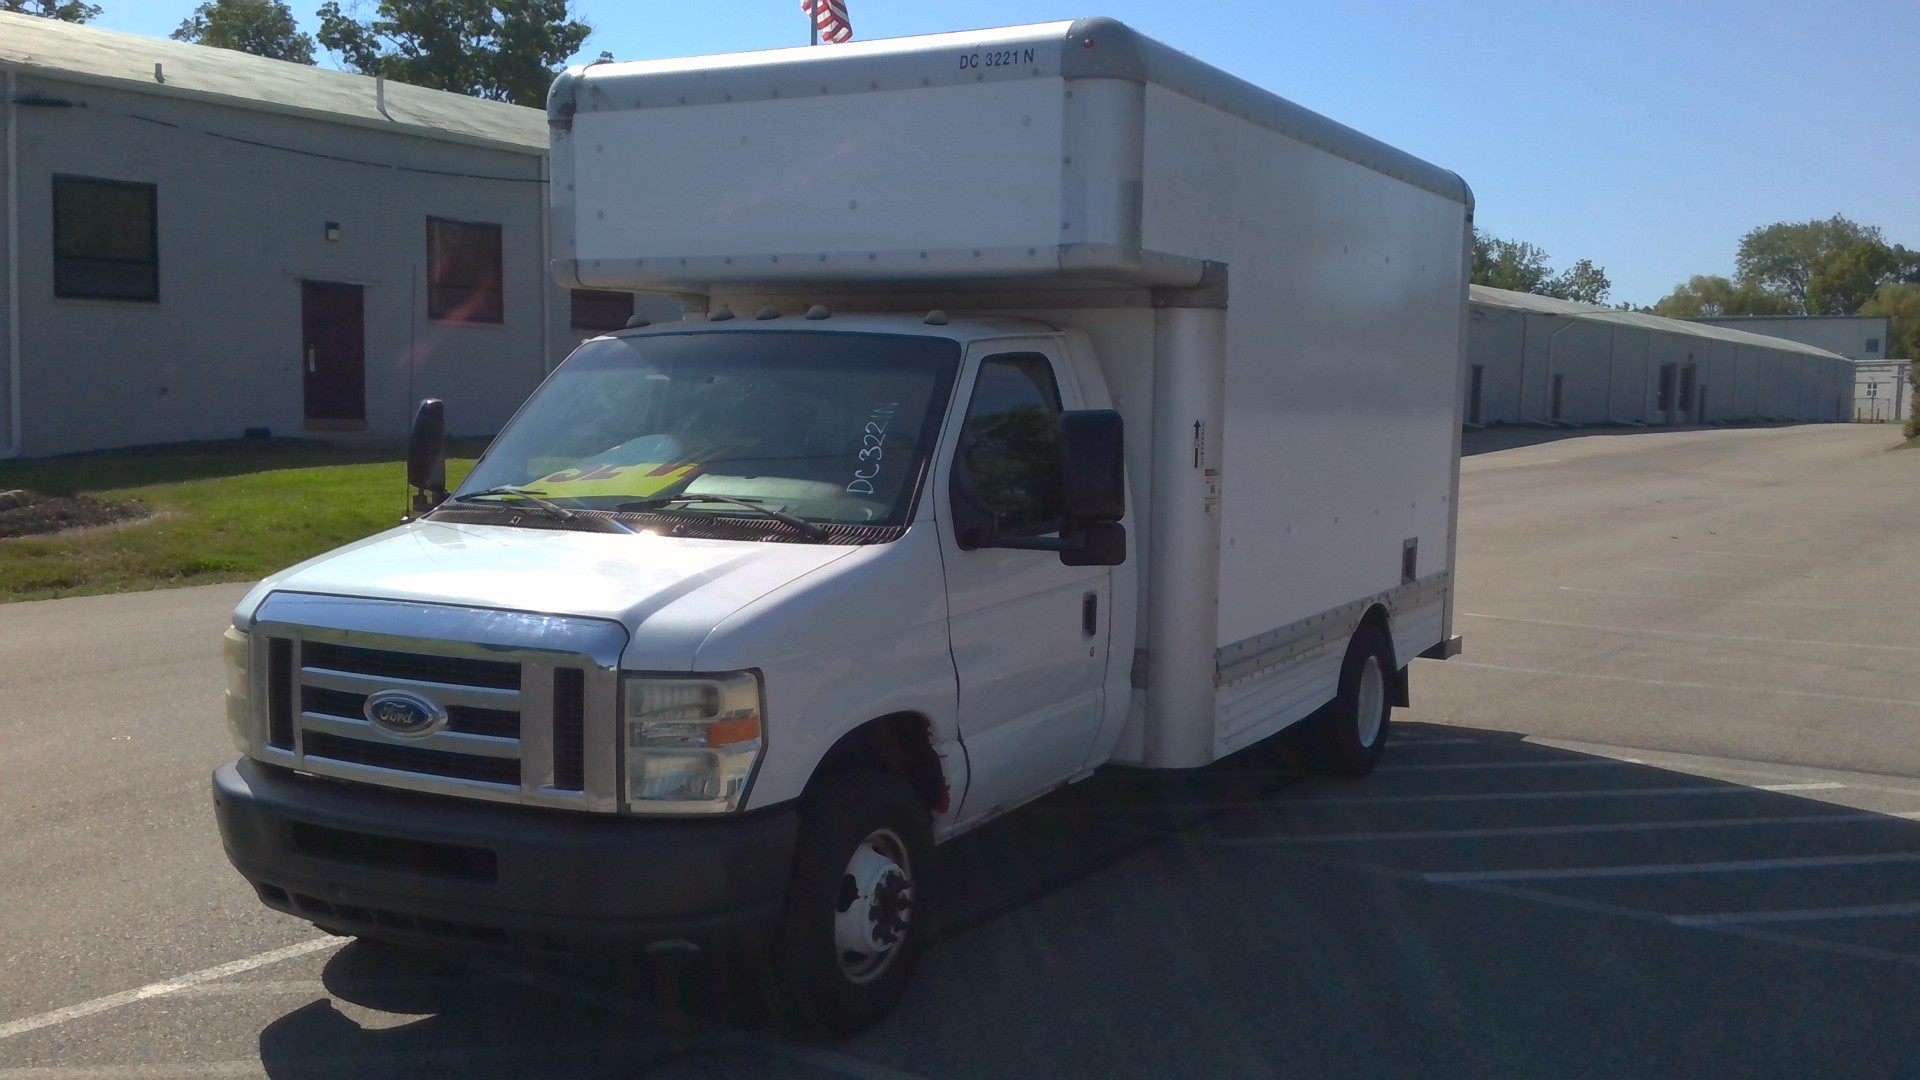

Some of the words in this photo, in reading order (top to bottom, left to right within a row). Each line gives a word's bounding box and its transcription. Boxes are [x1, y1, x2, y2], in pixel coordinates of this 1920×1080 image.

[960, 53, 979, 69] DC
[985, 50, 1018, 67] 3221
[1023, 48, 1034, 63] N
[380, 702, 414, 724] Ford
